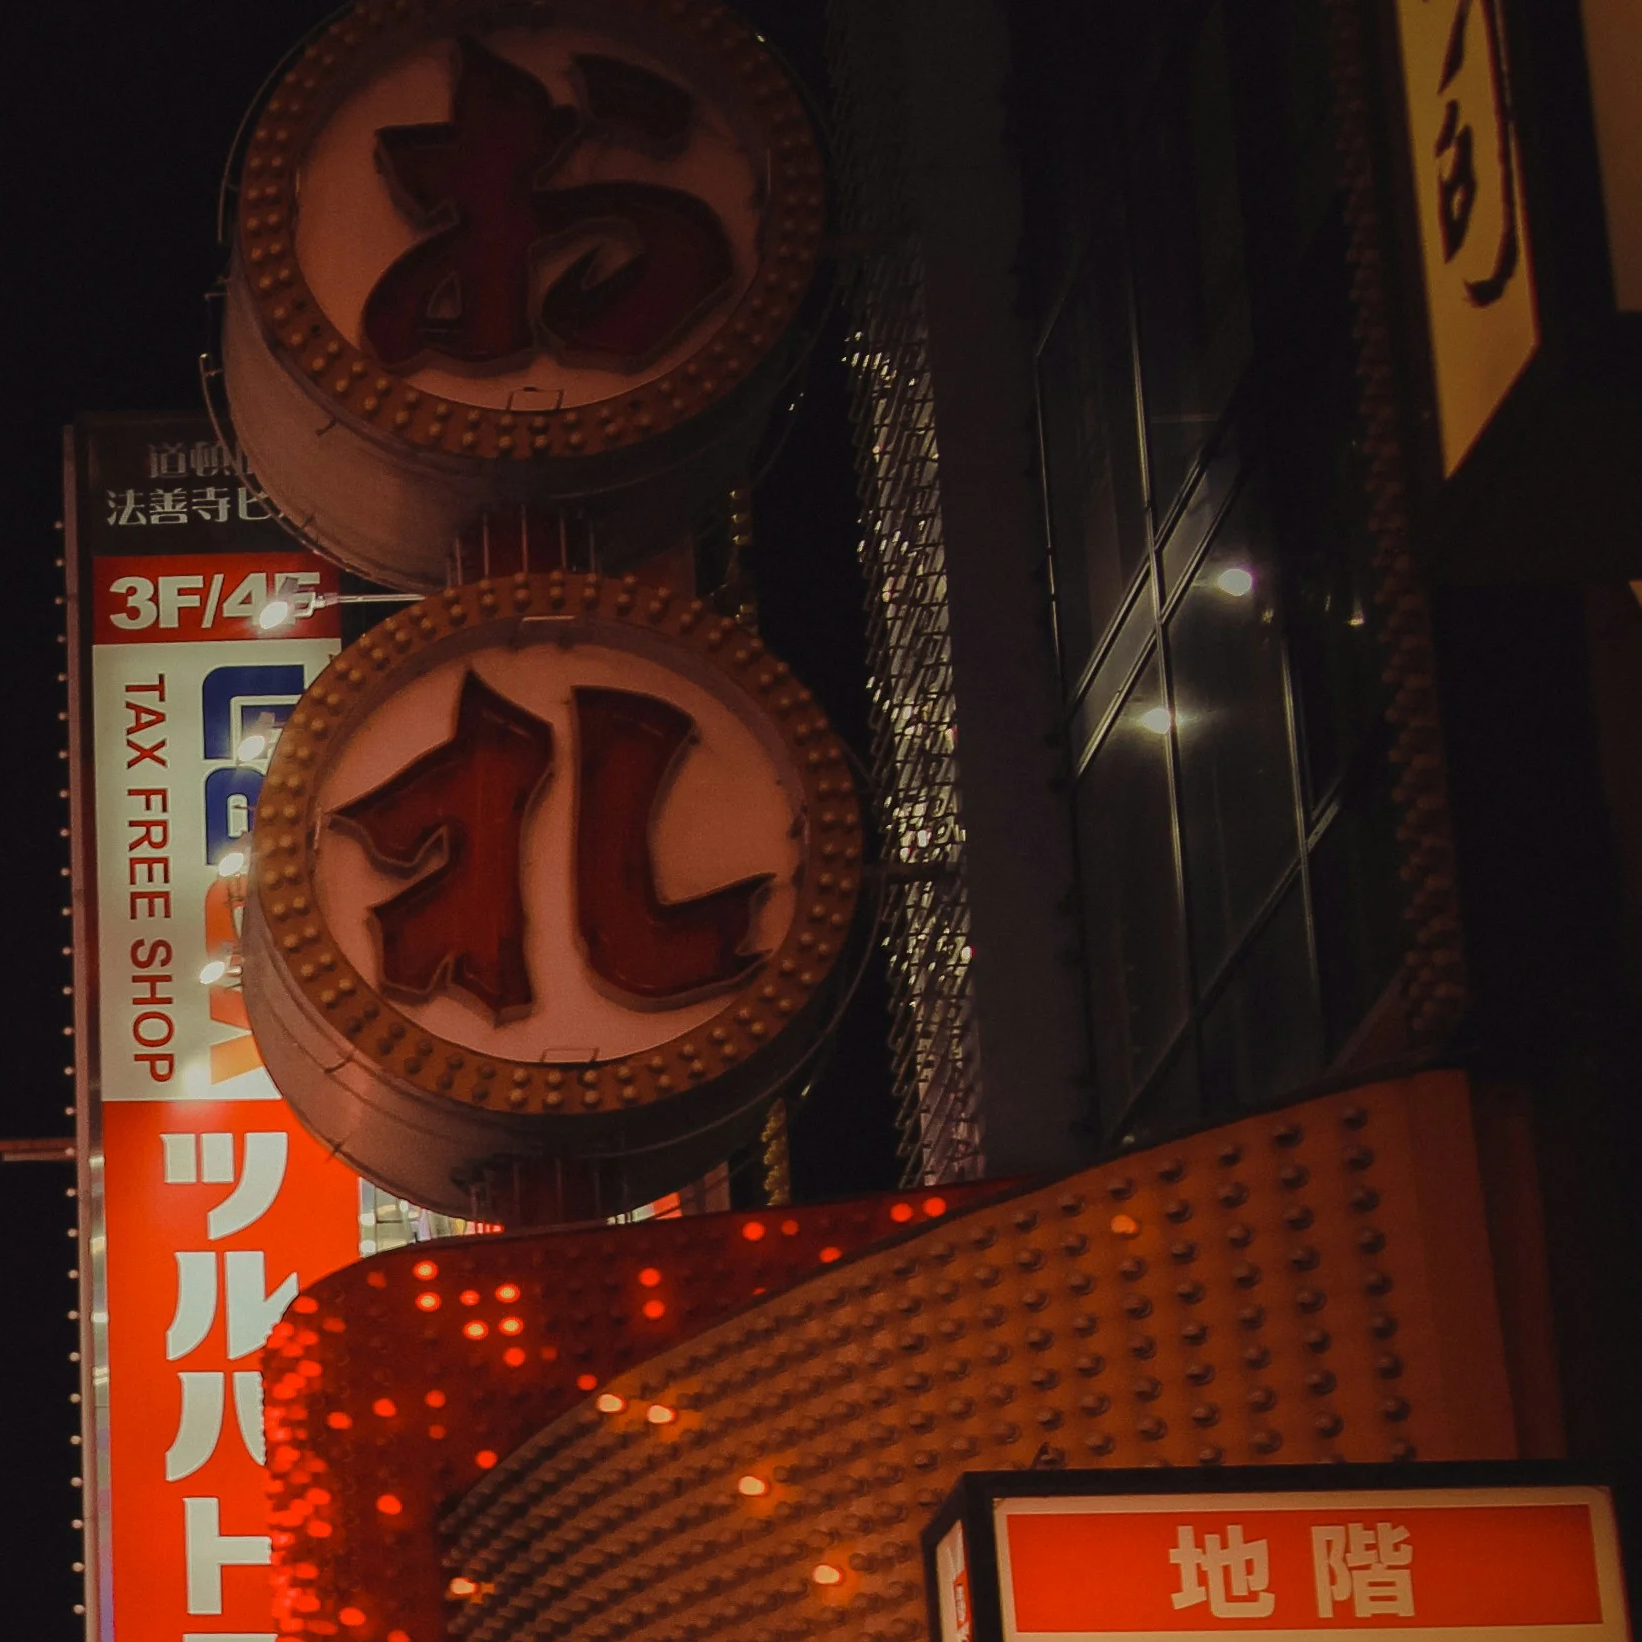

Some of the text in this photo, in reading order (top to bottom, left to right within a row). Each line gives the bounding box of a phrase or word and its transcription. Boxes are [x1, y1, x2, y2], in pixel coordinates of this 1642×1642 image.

[124, 673, 176, 1084] TAX FREE SHOP
[1169, 1522, 1416, 1620] 地階
